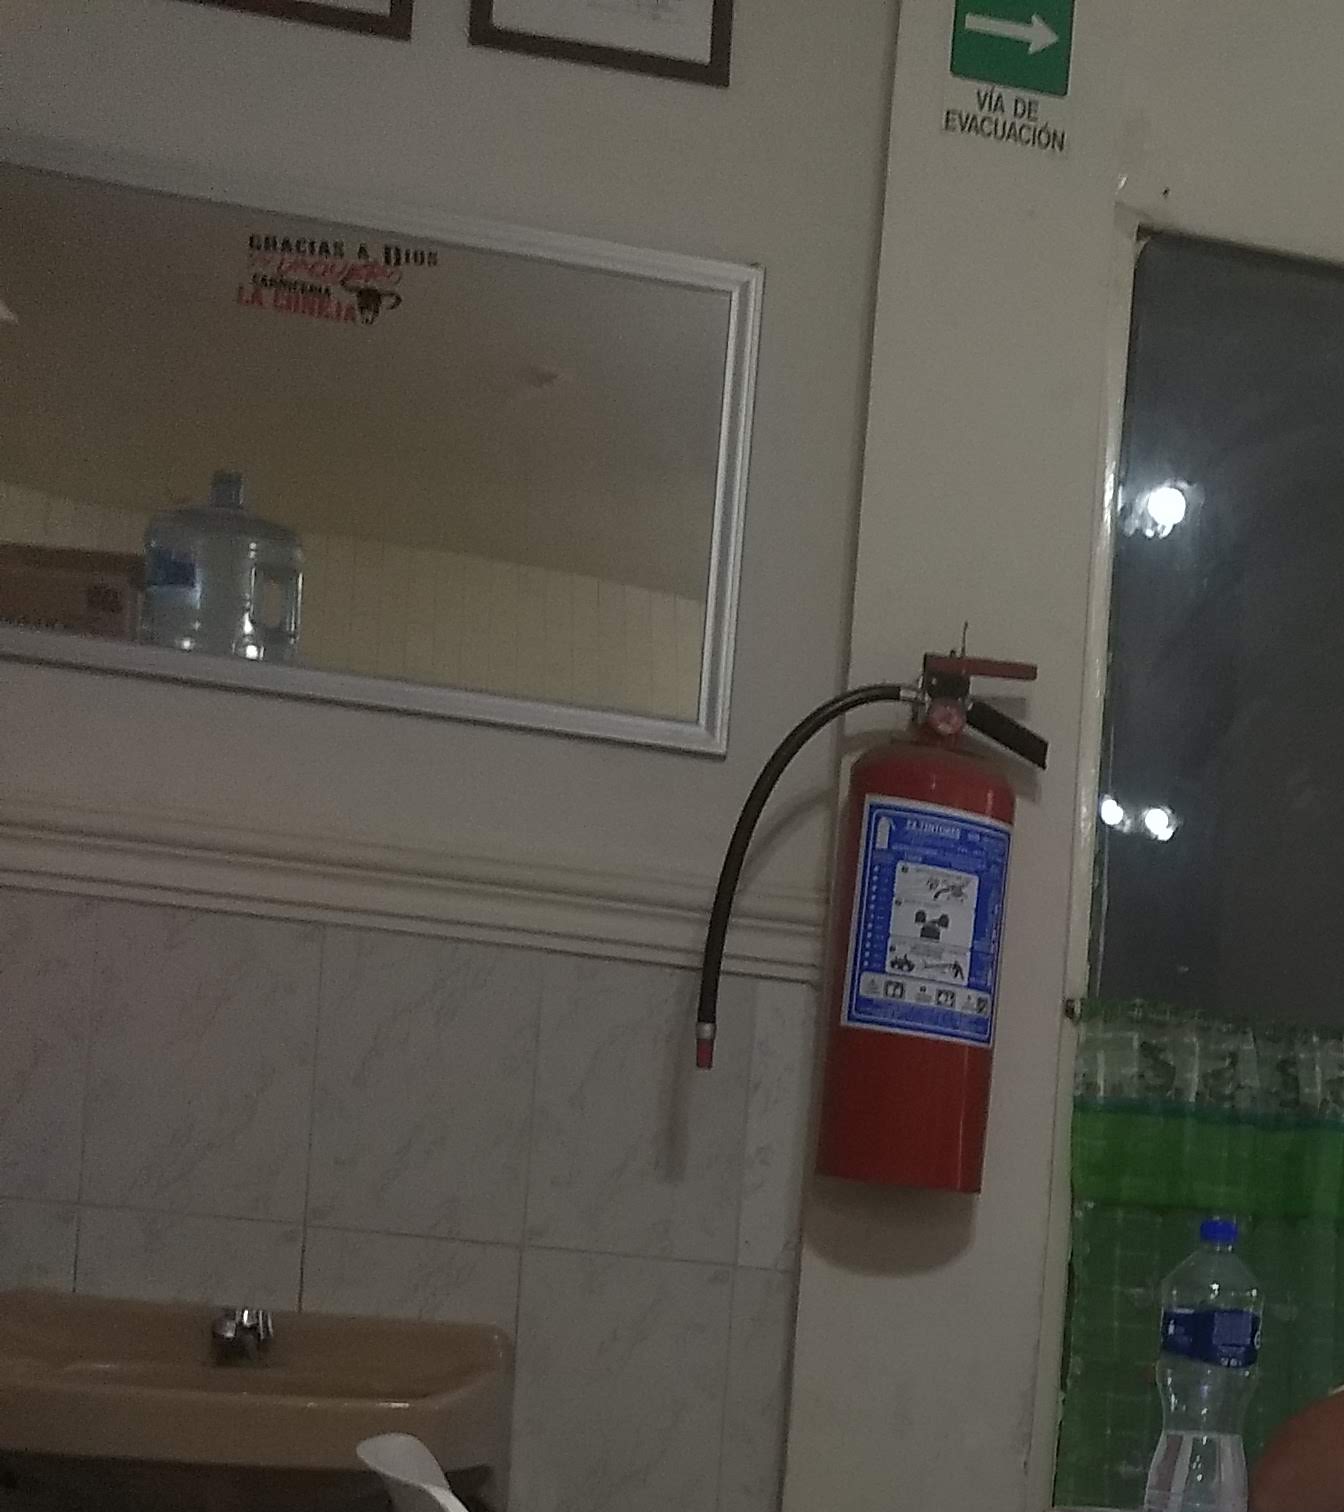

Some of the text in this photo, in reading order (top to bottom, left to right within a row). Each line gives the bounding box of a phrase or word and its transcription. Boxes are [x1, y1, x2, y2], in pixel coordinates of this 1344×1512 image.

[976, 85, 1039, 122] VÍA DE
[944, 109, 1065, 152] EVACUACIÓN
